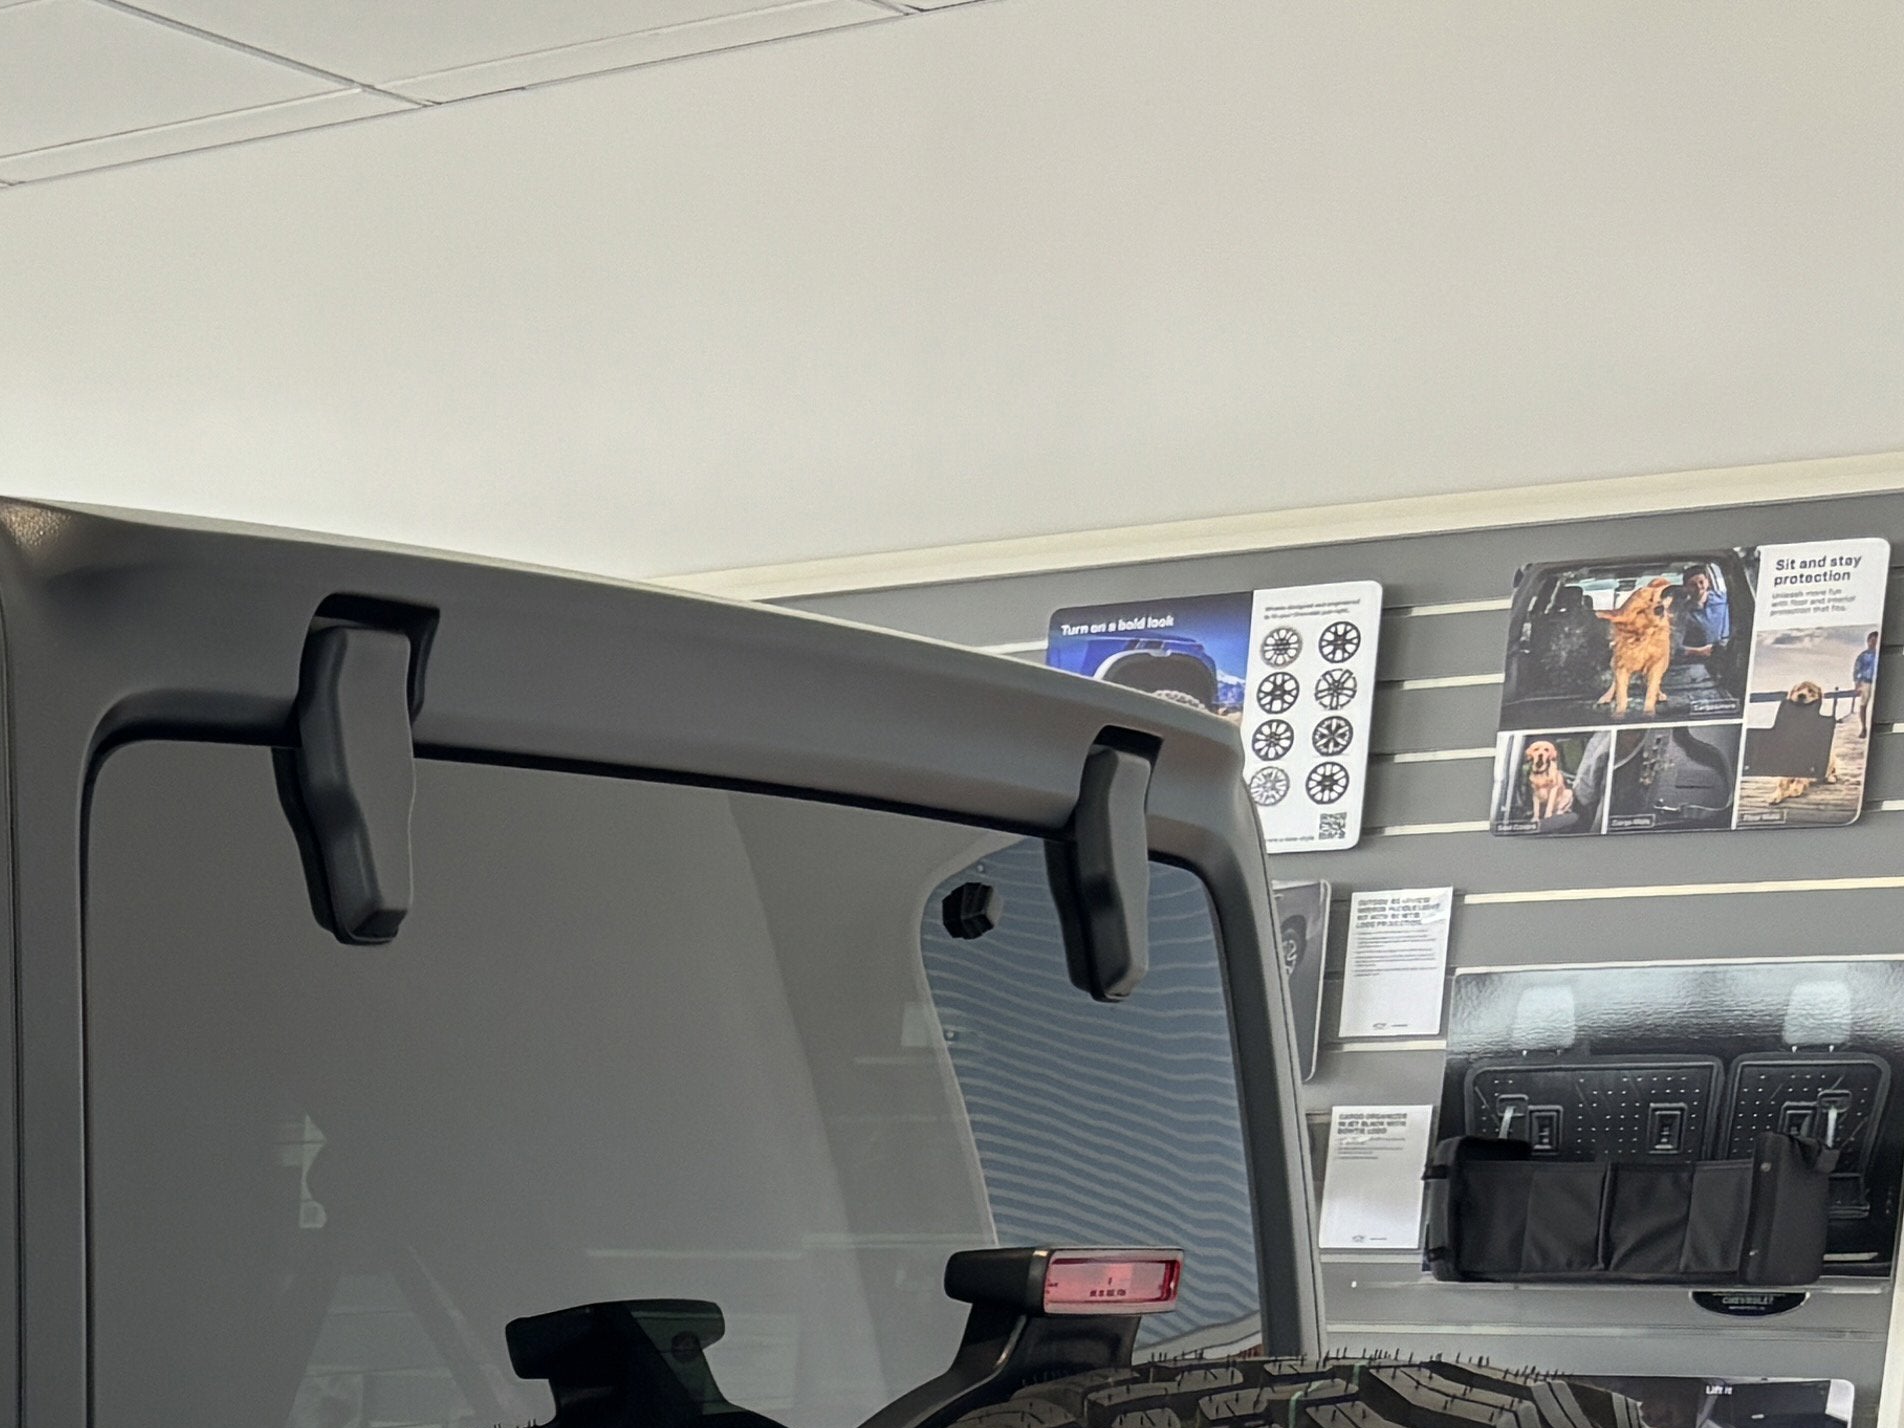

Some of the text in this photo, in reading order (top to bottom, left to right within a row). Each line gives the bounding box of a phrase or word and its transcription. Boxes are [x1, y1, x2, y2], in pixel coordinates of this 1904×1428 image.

[1775, 555, 1863, 571] Sit and stay
[1773, 570, 1852, 587] protection
[1060, 624, 1089, 637] Turn
[1090, 623, 1107, 634] on
[1118, 617, 1146, 632] bold
[1147, 615, 1175, 629] look
